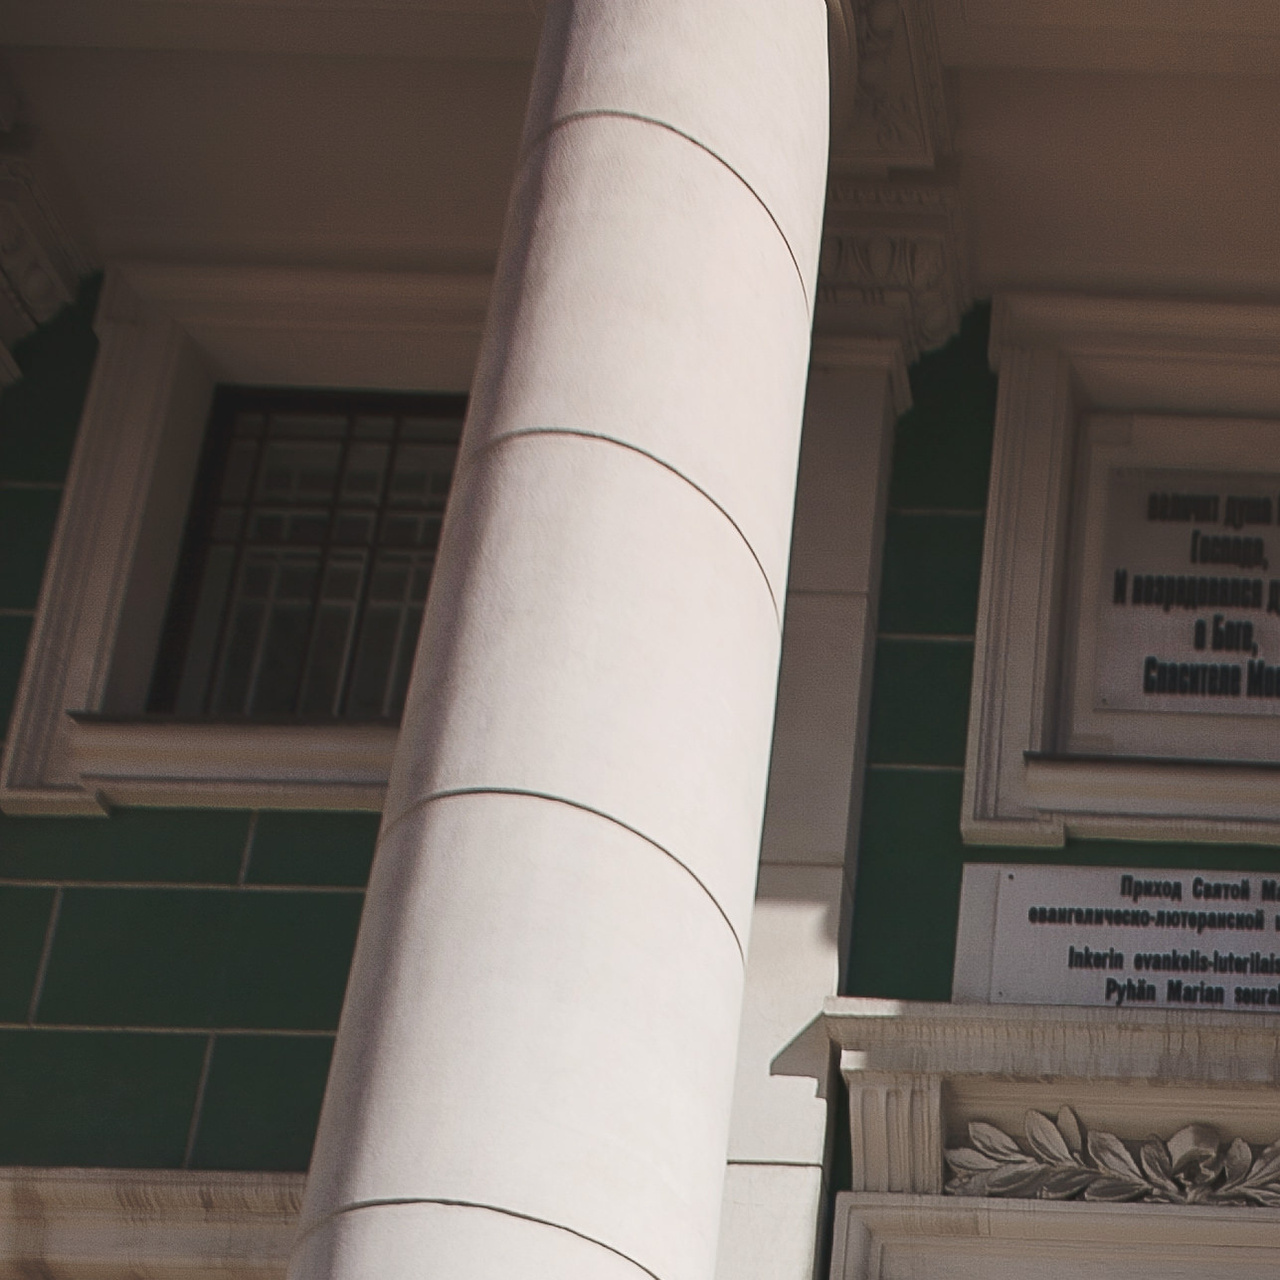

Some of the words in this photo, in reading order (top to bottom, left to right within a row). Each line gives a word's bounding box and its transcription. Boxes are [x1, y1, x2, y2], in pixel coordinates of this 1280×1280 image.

[1113, 568, 1127, 605] И
[1143, 656, 1241, 696] Спасителе
[1120, 875, 1182, 902] Приход
[1192, 877, 1250, 901] Святой
[1028, 906, 1265, 934] евангелическо-лютеранской
[1068, 945, 1124, 970] Inkerin
[1105, 977, 1156, 1006] Pyhän
[1167, 979, 1225, 1004] Marian
